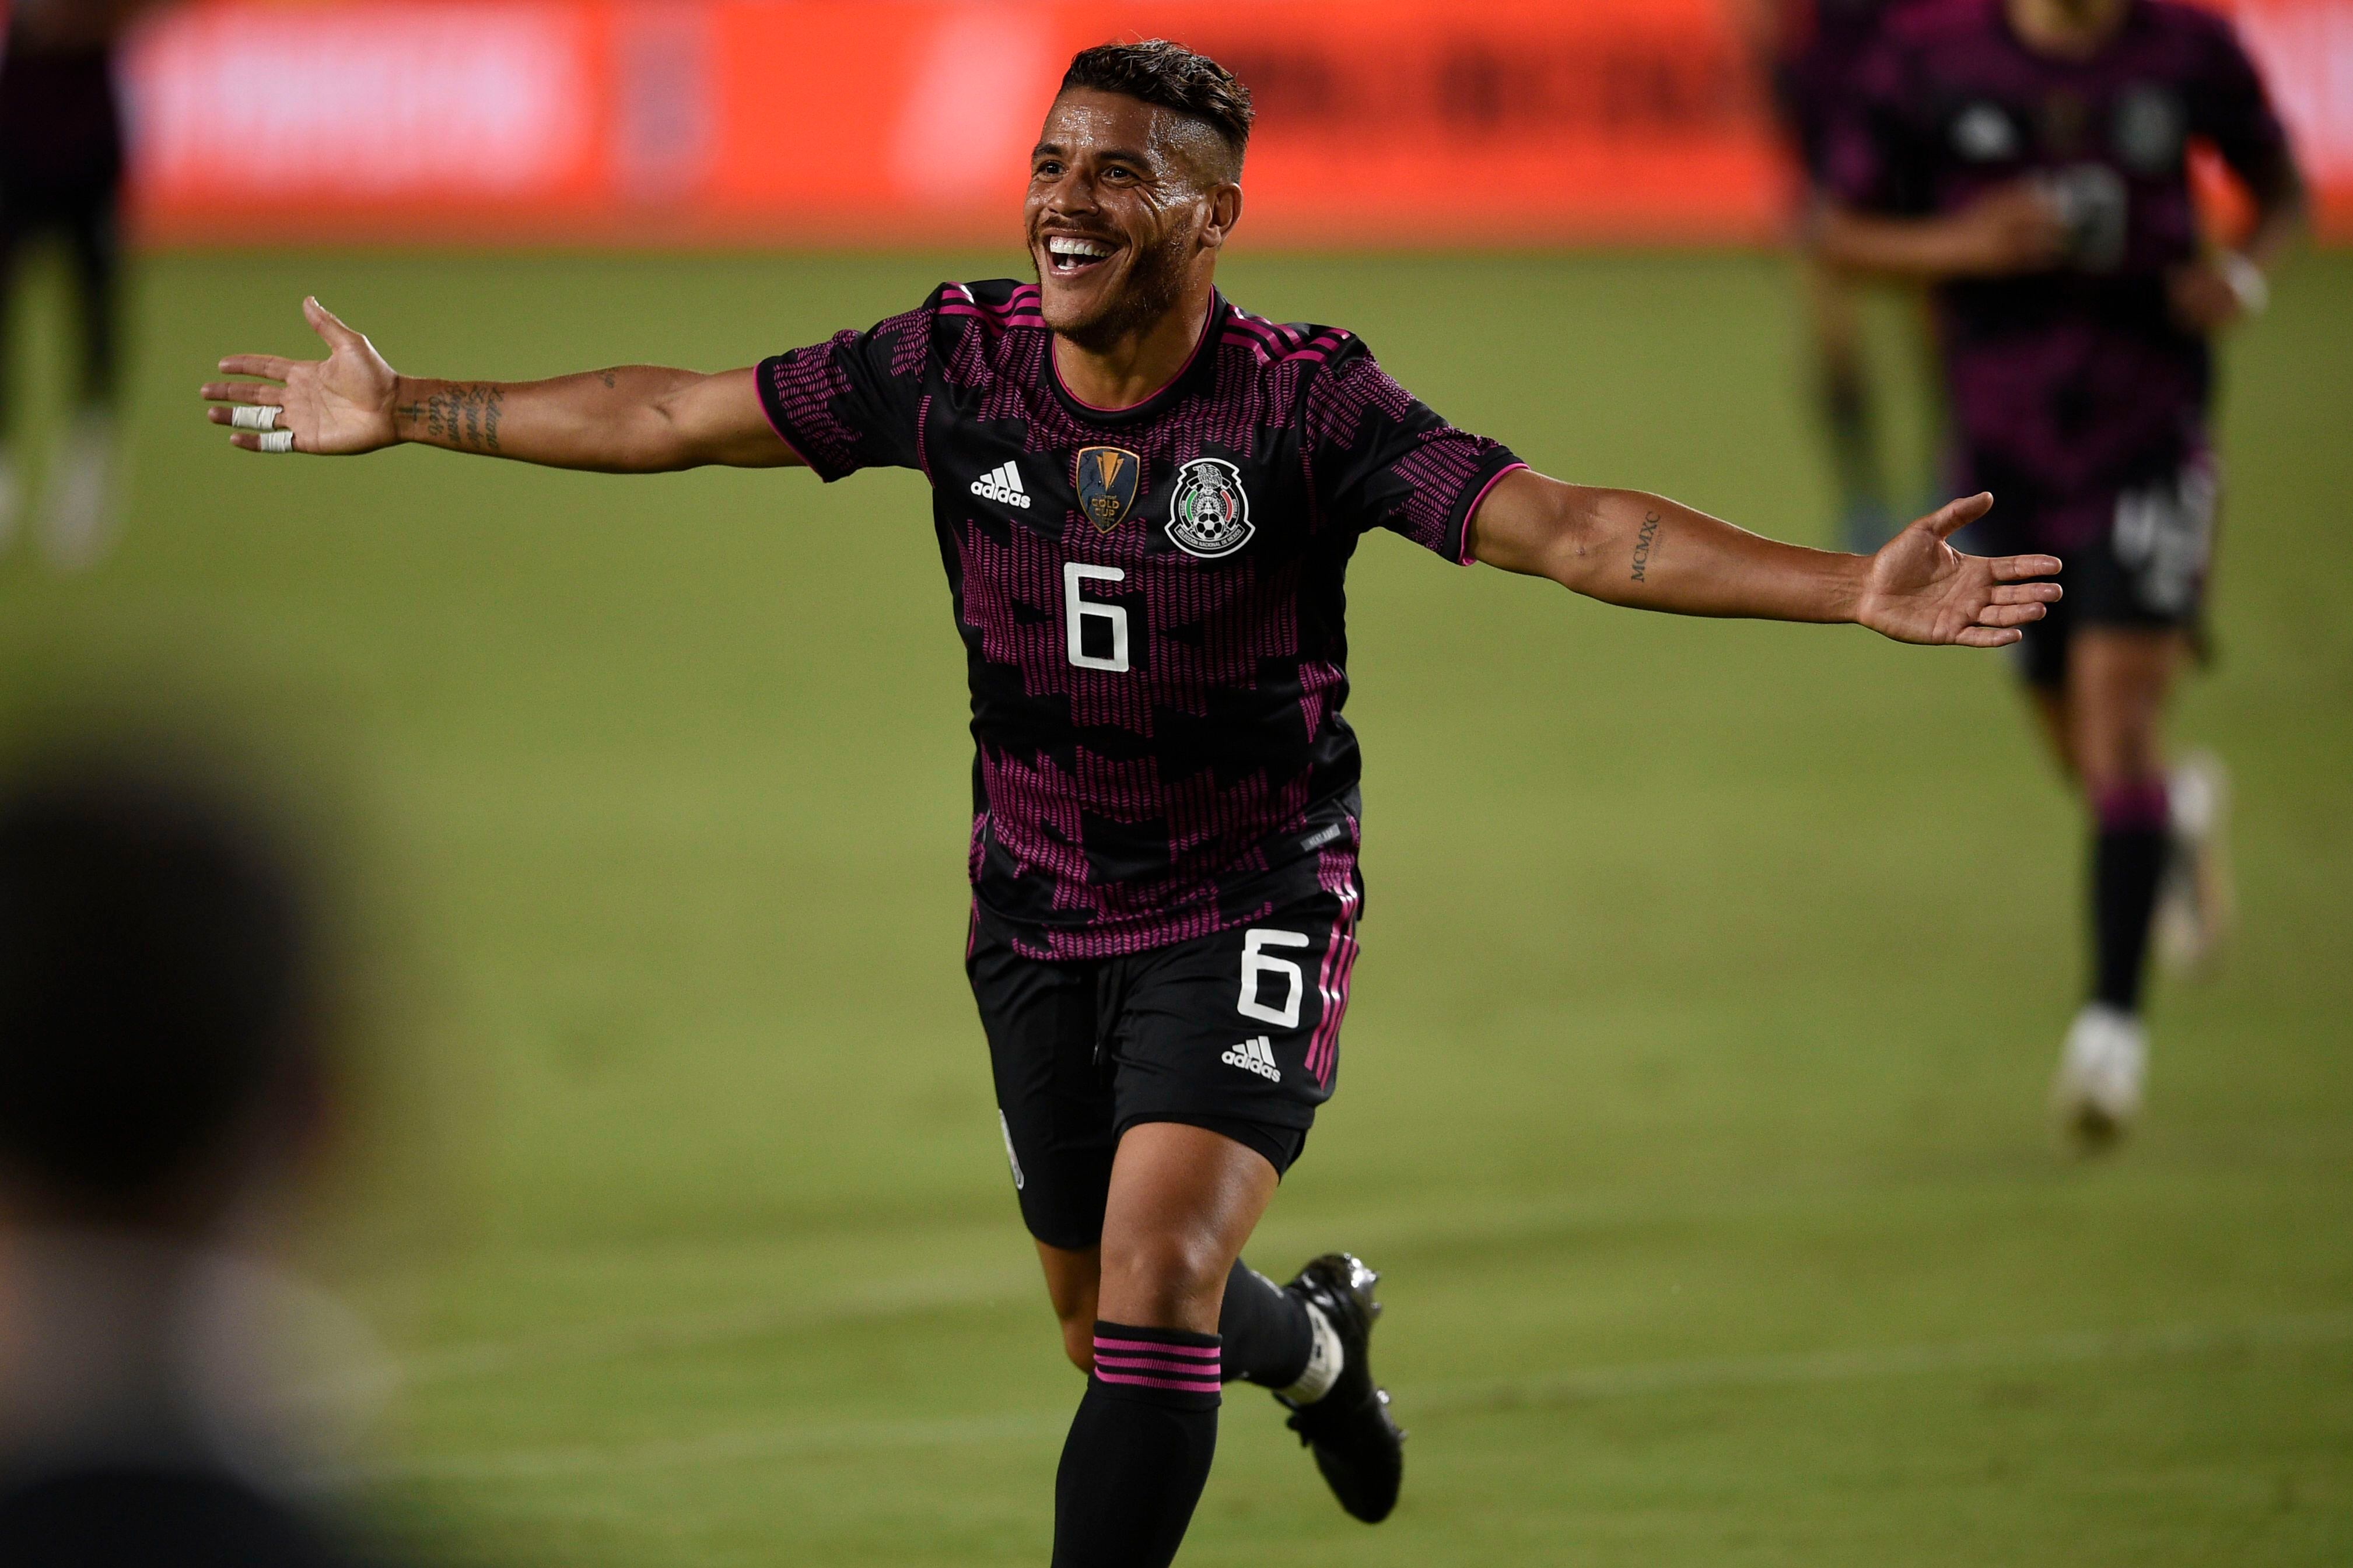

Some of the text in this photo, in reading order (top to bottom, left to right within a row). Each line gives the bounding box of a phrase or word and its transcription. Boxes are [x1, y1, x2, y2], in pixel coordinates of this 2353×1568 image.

[970, 480, 1031, 509] adidas
[1091, 498, 1119, 509] GOLD
[1095, 507, 1115, 518] CUP
[1631, 511, 1661, 583] MCMXC
[1064, 562, 1129, 672] 6
[1237, 929, 1309, 1028] 6
[1221, 1050, 1281, 1083] adidas
